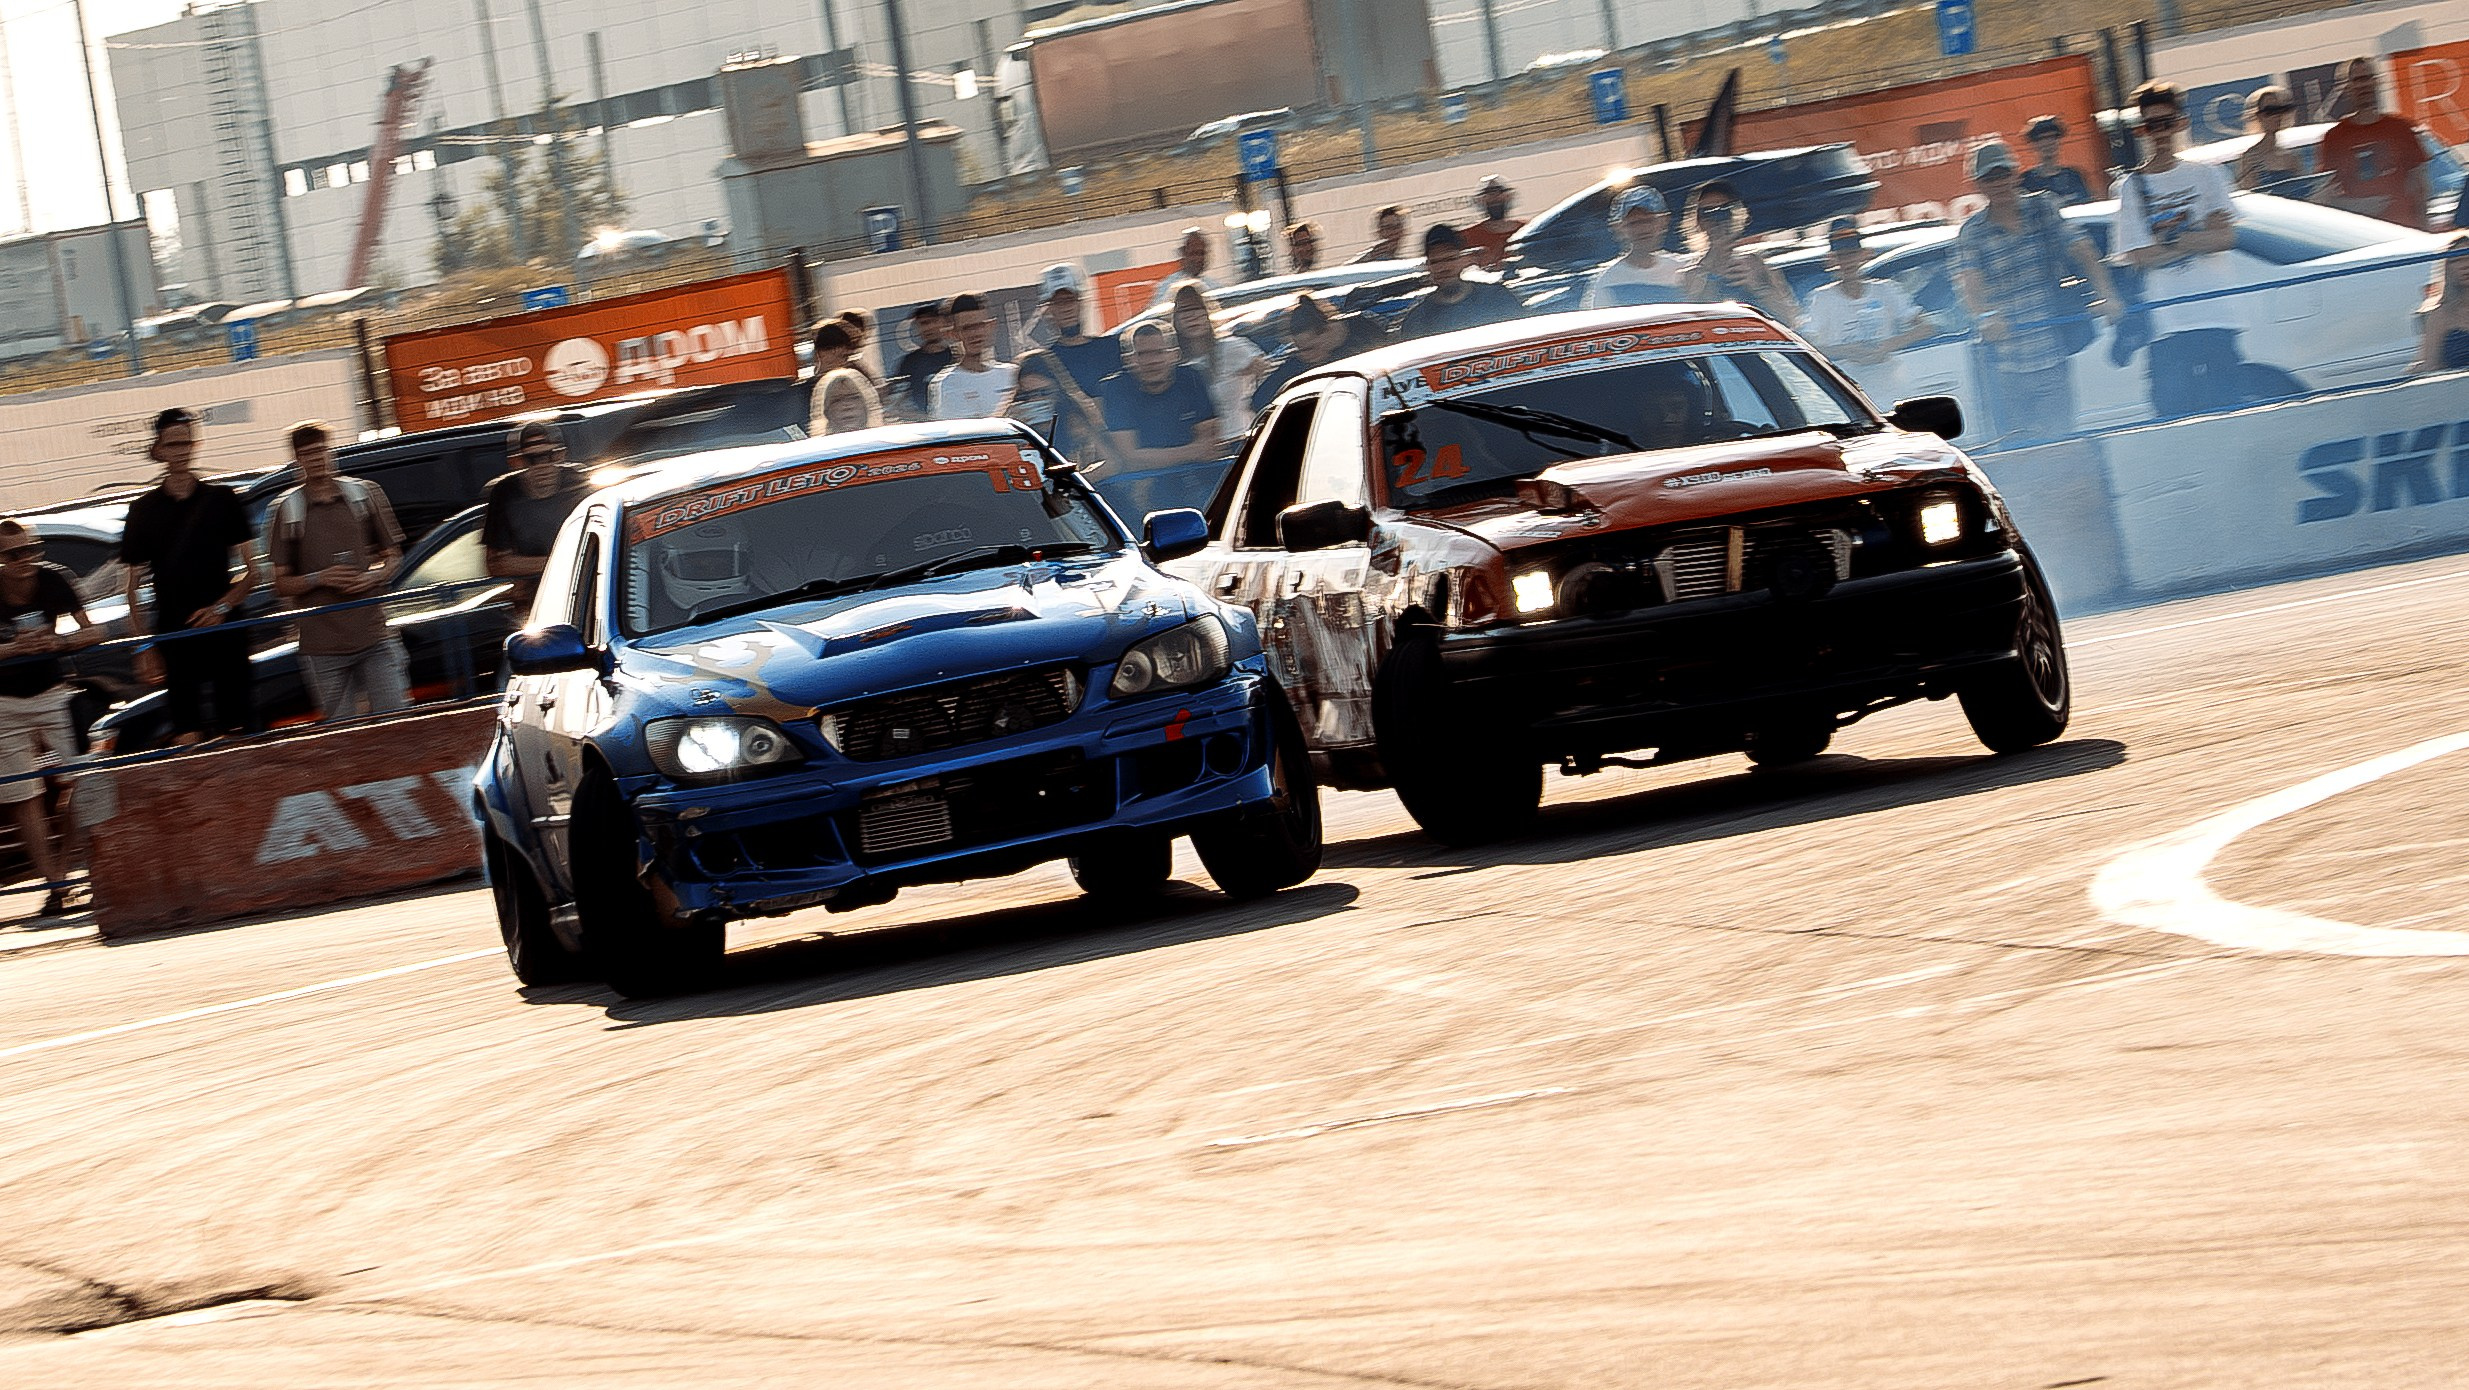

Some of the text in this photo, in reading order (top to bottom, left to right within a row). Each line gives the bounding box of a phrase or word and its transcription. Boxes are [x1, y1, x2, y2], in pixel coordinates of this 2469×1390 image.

[1440, 349, 1548, 385] DRIFT
[1549, 333, 1641, 360] LETO
[1391, 443, 1472, 488] 24
[655, 485, 764, 530] DRIFT
[765, 464, 858, 498] LETO
